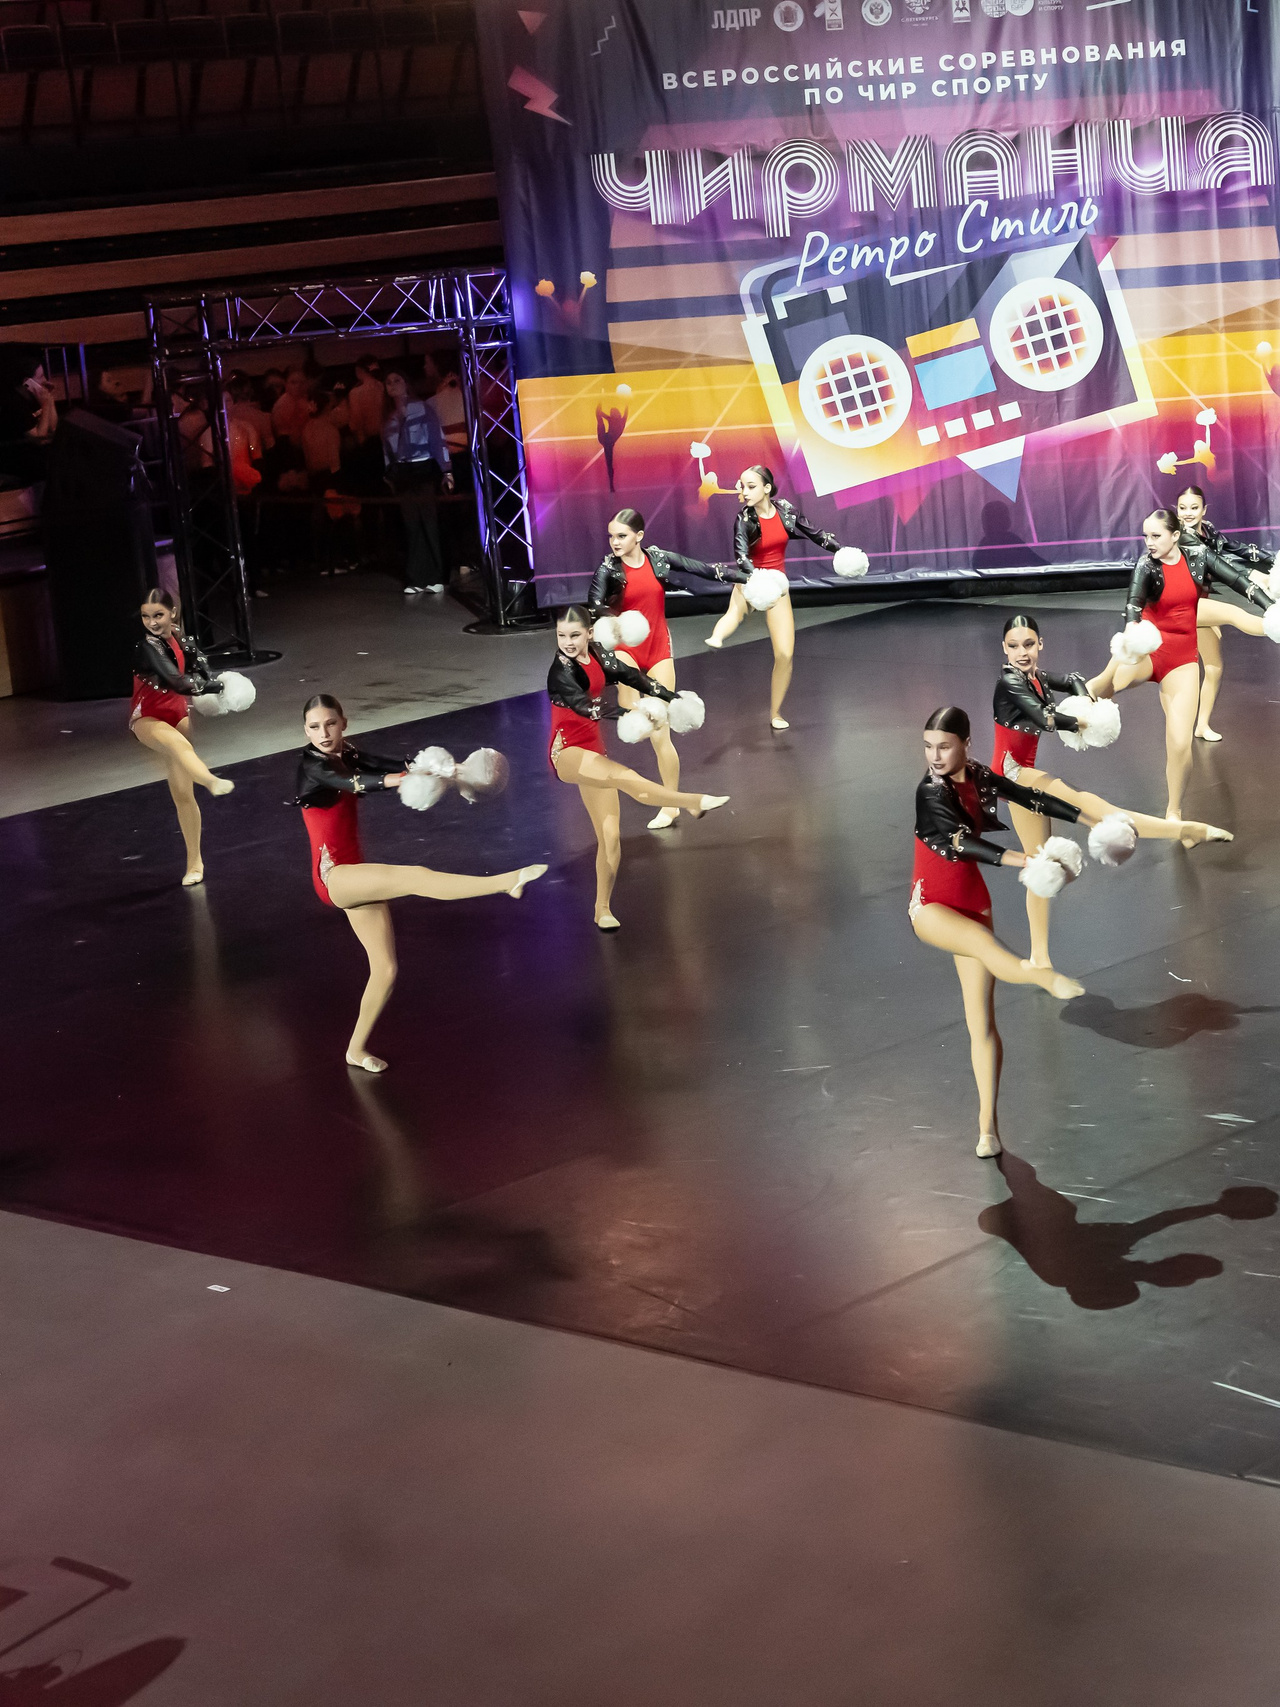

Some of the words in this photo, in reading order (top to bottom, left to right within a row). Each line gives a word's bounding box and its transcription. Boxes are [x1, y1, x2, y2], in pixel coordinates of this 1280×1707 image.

[711, 8, 762, 31] ЛДПР
[662, 56, 925, 90] ВСЕРОССИЙСКИЕ
[938, 39, 1187, 72] СОРЕВНОВАНИЯ
[804, 86, 844, 106] ПО
[857, 82, 917, 102] ЧИР
[931, 73, 1049, 98] СПОРТУ
[795, 230, 938, 288] Ретро
[956, 198, 1100, 254] Стиль
